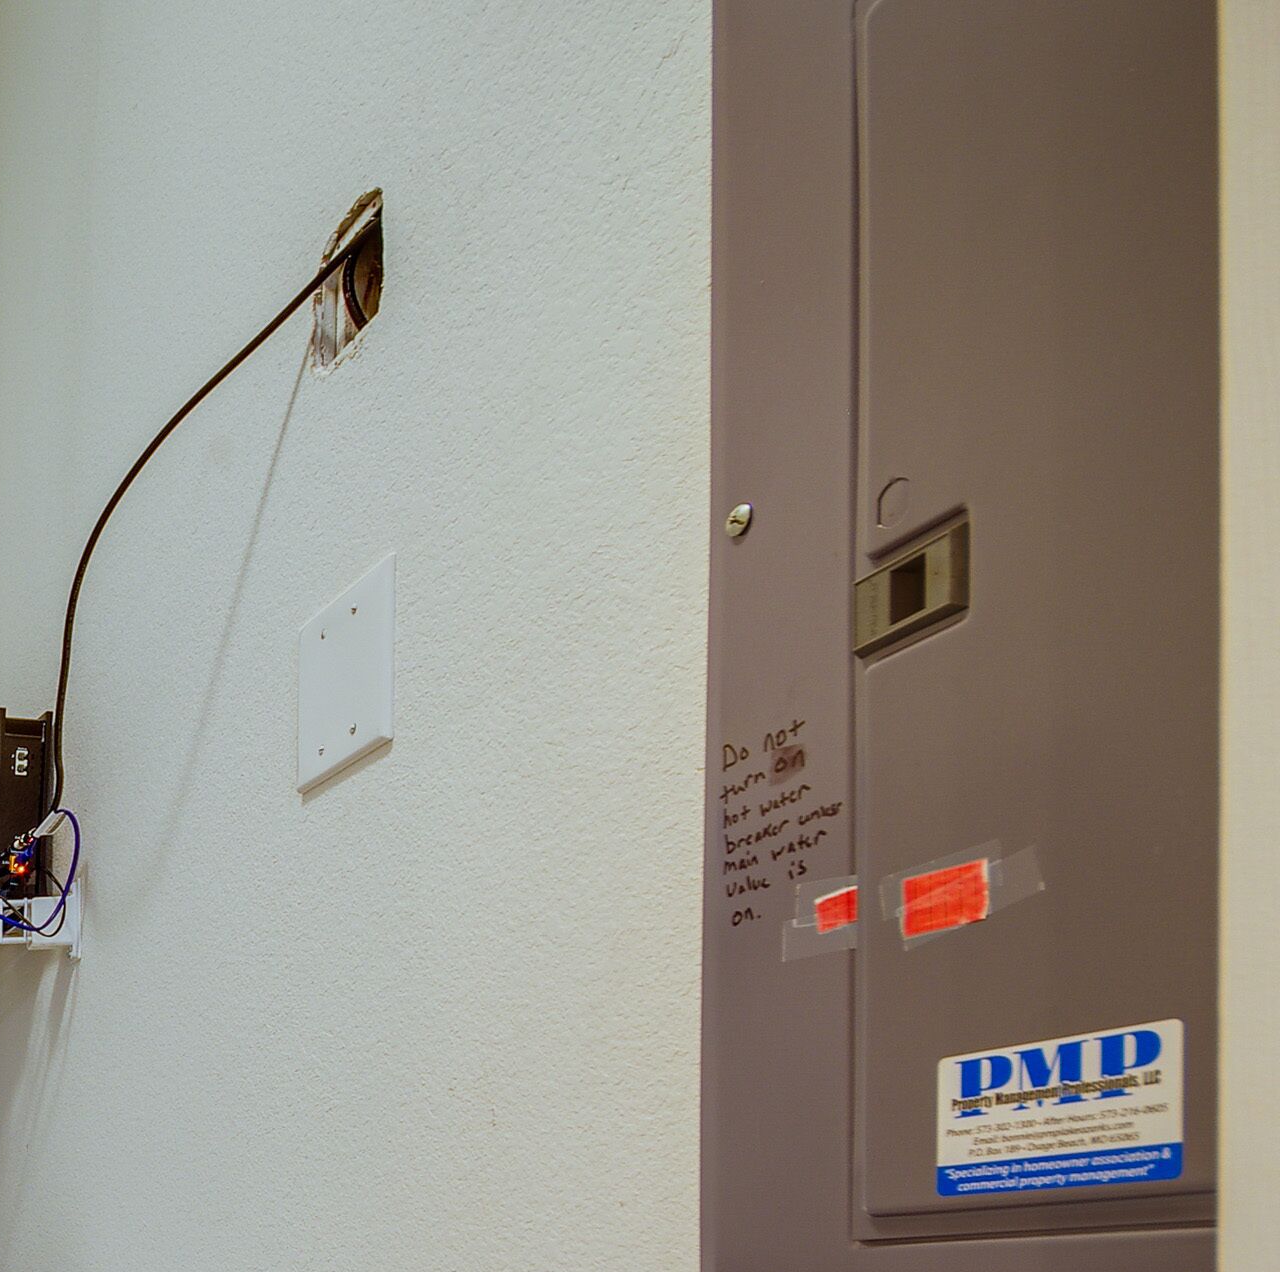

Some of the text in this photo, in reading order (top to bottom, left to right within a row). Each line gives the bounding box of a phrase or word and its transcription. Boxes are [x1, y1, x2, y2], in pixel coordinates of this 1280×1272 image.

[722, 719, 806, 773] Do not
[719, 750, 806, 804] turn on
[724, 784, 812, 829] hot water
[723, 830, 827, 875] main water
[725, 820, 790, 855] breaker
[788, 860, 808, 880] is
[954, 1030, 1162, 1119] PMP
[951, 1093, 992, 1112] Property
[995, 1083, 1060, 1106] Management
[1023, 1156, 1090, 1172] homeowner
[1091, 1149, 1160, 1166] association
[1161, 1147, 1172, 1159] &
[957, 1176, 1019, 1192] commercial
[1019, 1173, 1066, 1190] property
